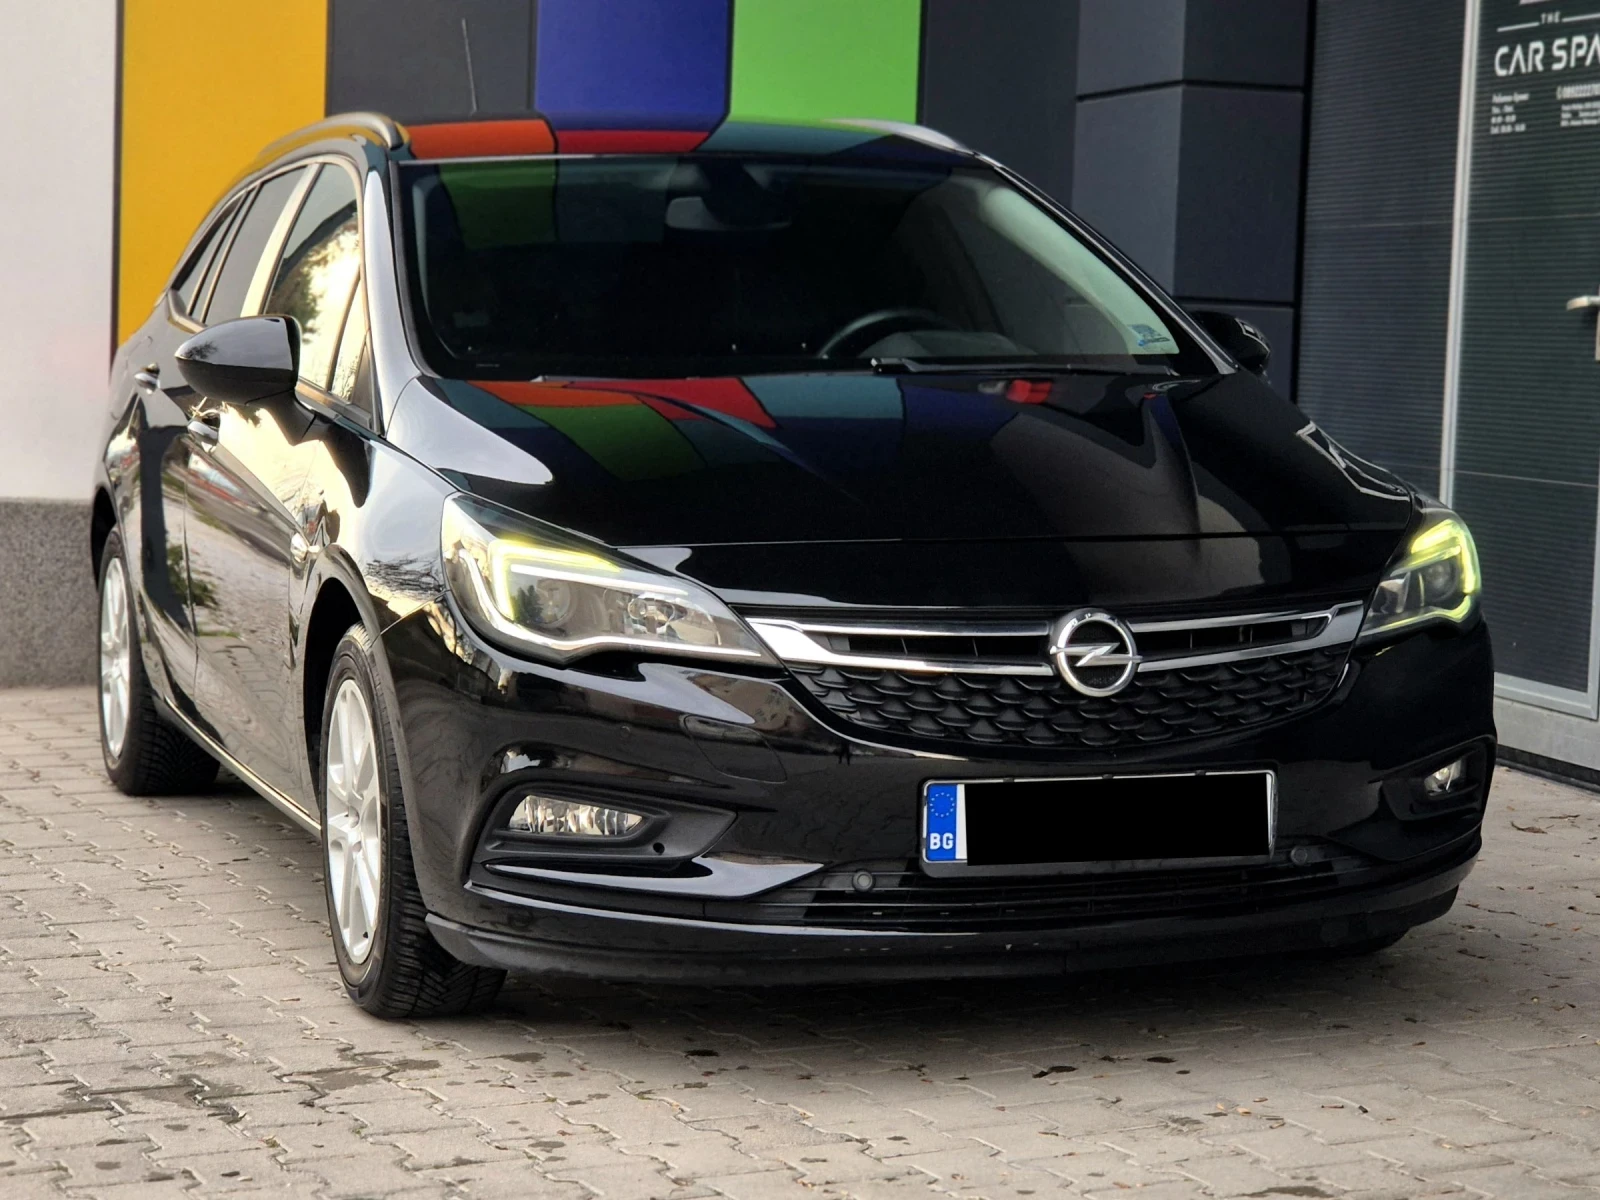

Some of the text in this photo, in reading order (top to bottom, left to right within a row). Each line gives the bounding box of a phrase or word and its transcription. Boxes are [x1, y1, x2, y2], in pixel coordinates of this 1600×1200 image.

[1541, 11, 1560, 24] THE
[1494, 41, 1544, 76] CAR
[929, 832, 954, 850] BG
